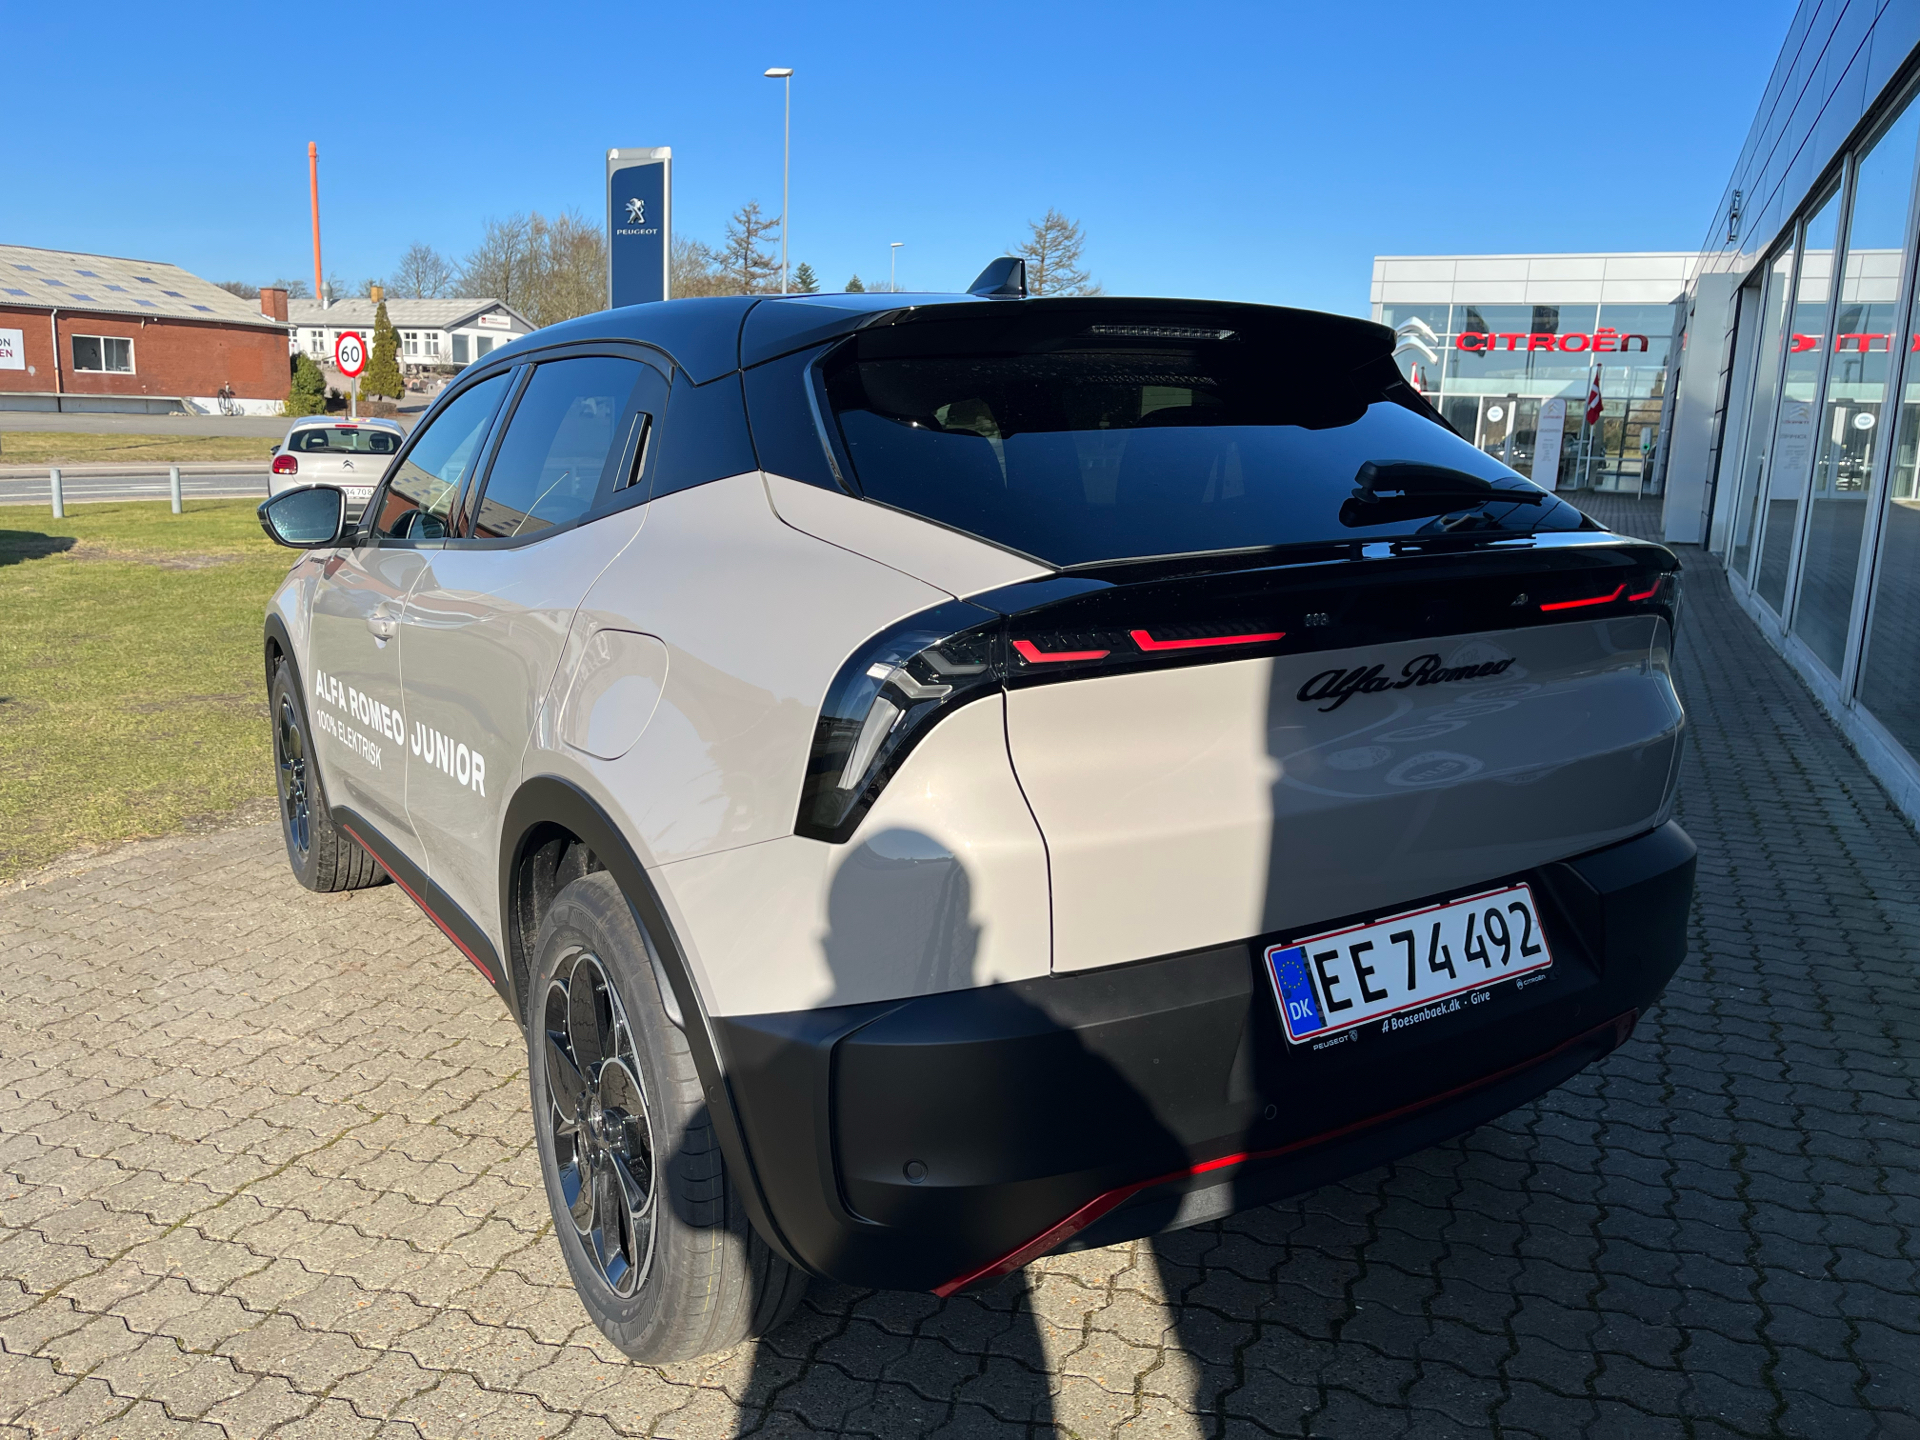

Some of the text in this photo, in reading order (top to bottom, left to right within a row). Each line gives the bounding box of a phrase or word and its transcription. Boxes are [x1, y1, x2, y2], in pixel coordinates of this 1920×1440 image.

[616, 228, 658, 236] PEUGEOT
[341, 345, 360, 363] 60
[1297, 664, 1394, 712] Alfa
[1393, 653, 1516, 690] Romeo
[315, 669, 486, 798] ALFA ROMEO JUNIOR
[316, 709, 382, 770] 100% ELEKTRISK
[1290, 997, 1313, 1021] DK
[1391, 998, 1461, 1031] Boesenbaek.dk
[1470, 990, 1491, 1005] Give
[1313, 1034, 1349, 1051] PEUGEOT
